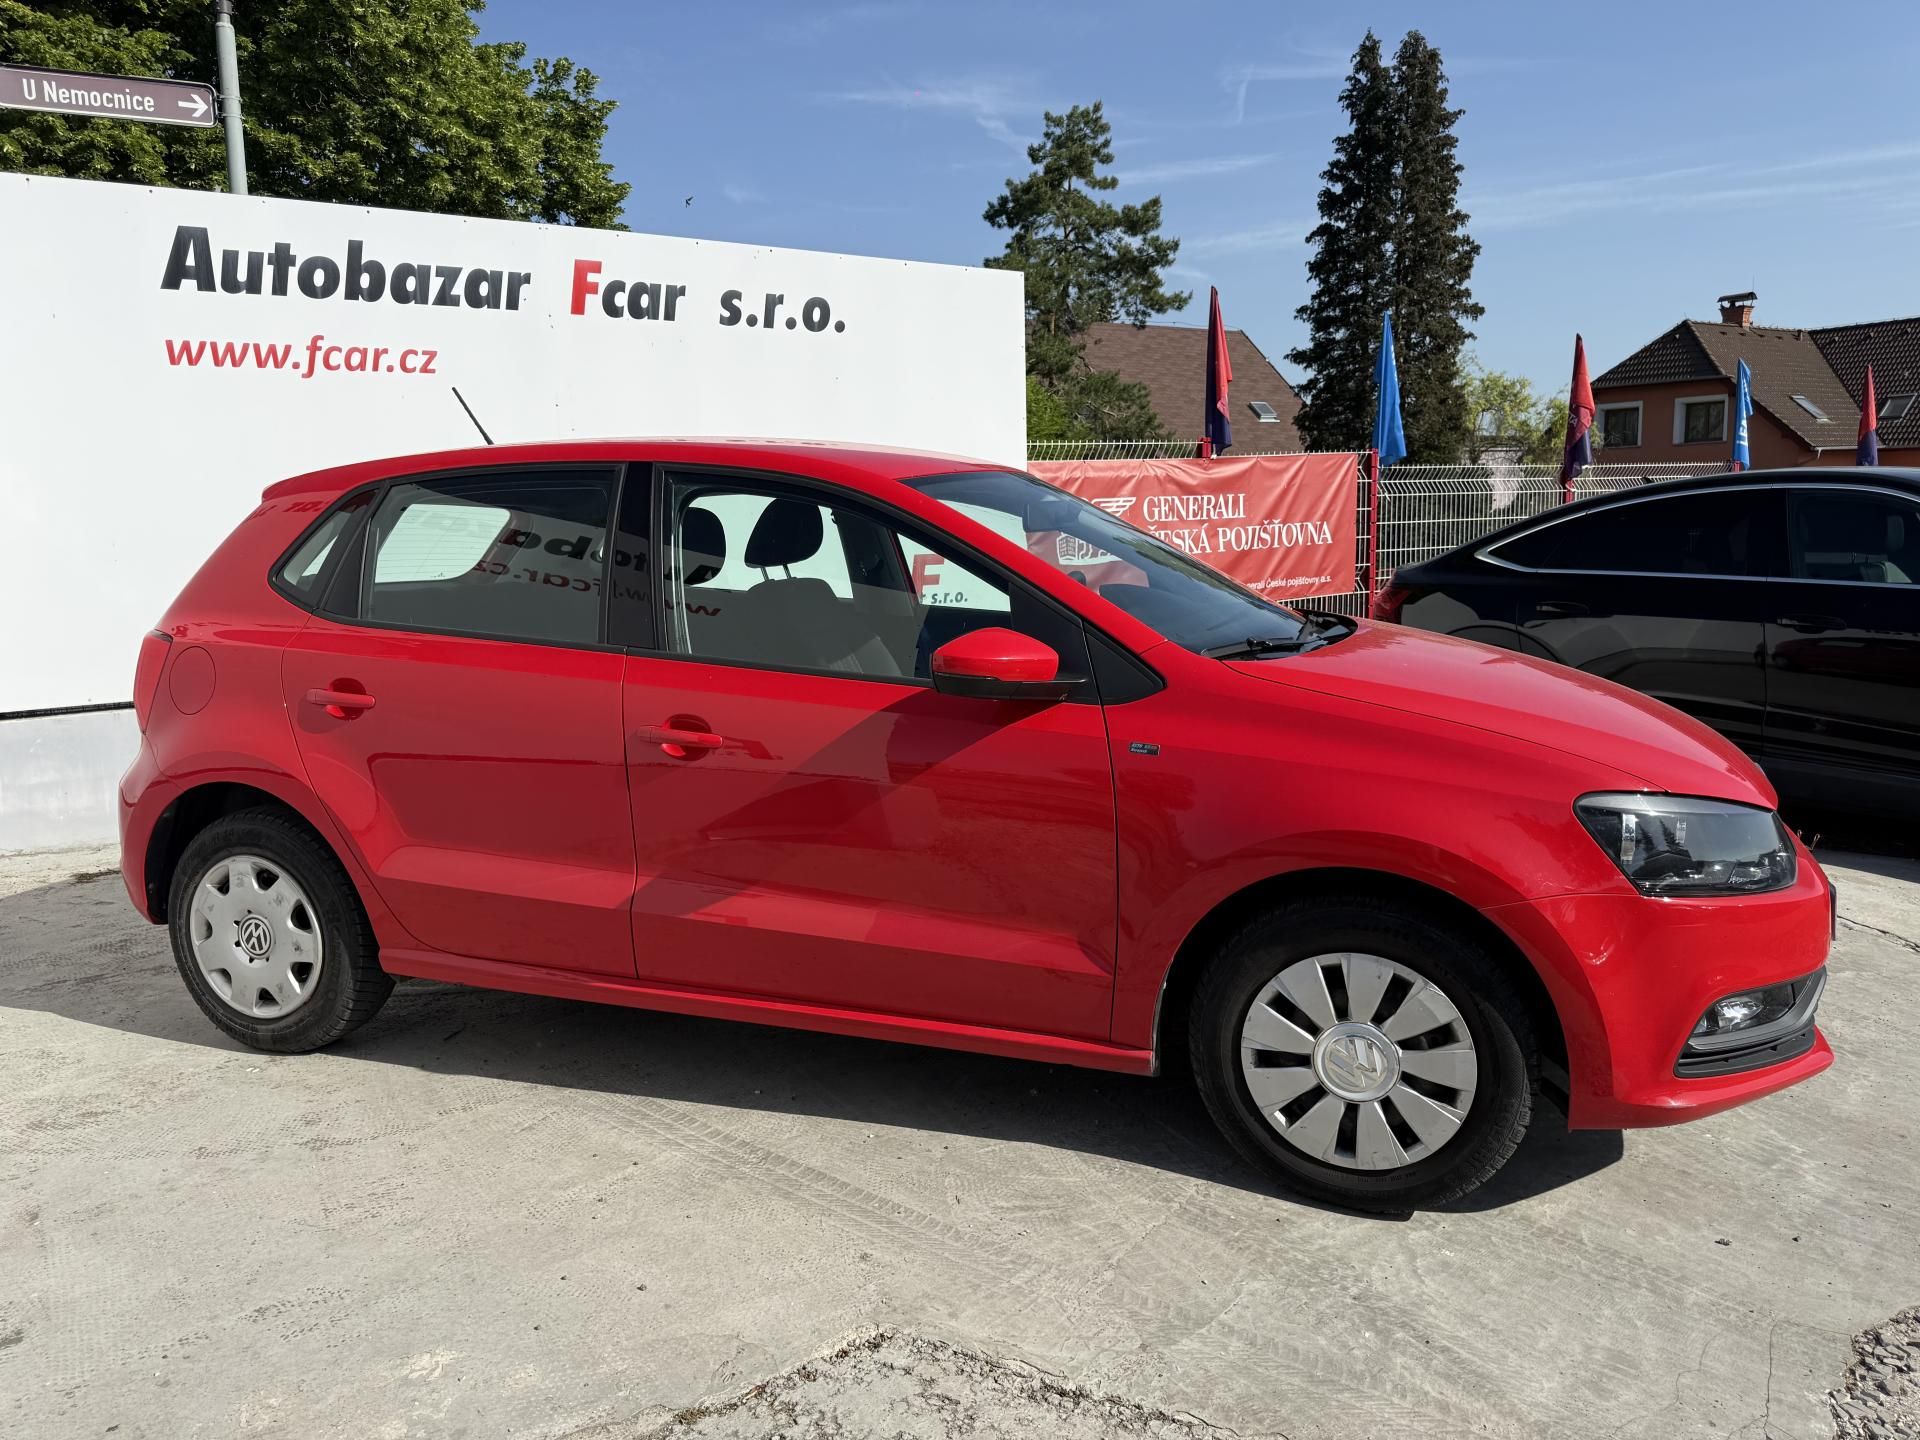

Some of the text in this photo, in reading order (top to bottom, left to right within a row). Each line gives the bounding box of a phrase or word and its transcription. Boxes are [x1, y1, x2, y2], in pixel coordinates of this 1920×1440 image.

[22, 78, 155, 112] U Nemocnice
[160, 225, 846, 333] Autobazar Fcar s.r.o.
[165, 335, 438, 379] www.fcar.cz
[1143, 493, 1246, 522] GENERALI
[1217, 518, 1334, 553] POJIŠŤOVNA
[931, 591, 968, 605] s.r.o.
